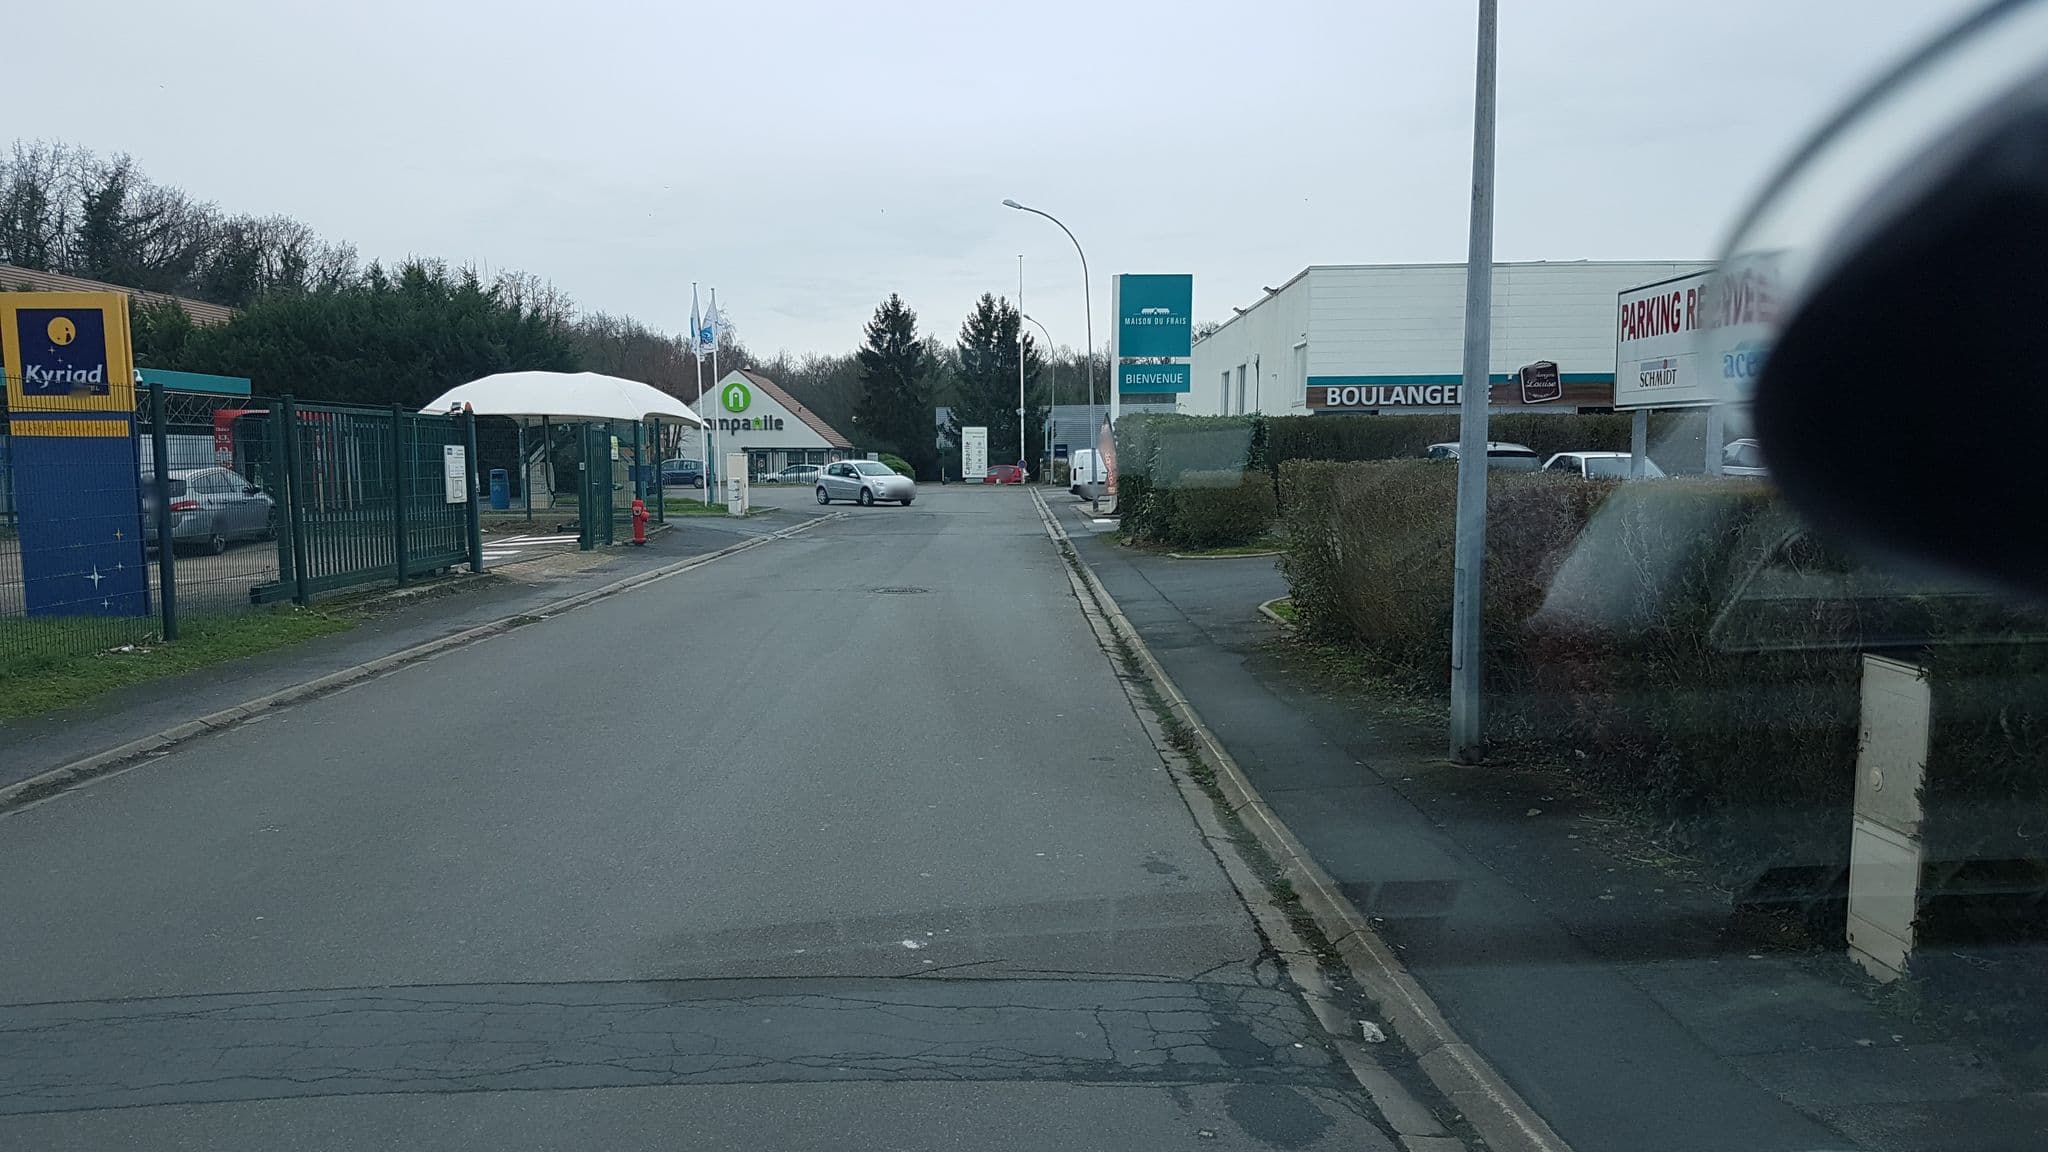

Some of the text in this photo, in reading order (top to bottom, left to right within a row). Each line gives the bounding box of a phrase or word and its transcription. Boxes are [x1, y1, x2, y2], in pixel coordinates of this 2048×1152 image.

[1124, 317, 1152, 325] MAISON
[1166, 317, 1187, 325] FRAIS
[1621, 290, 1681, 342] PARKING
[25, 364, 103, 389] Kyriad
[1125, 373, 1184, 384] BIENVENUE
[1639, 368, 1678, 388] SCHMIDT
[703, 414, 784, 436] ampanile
